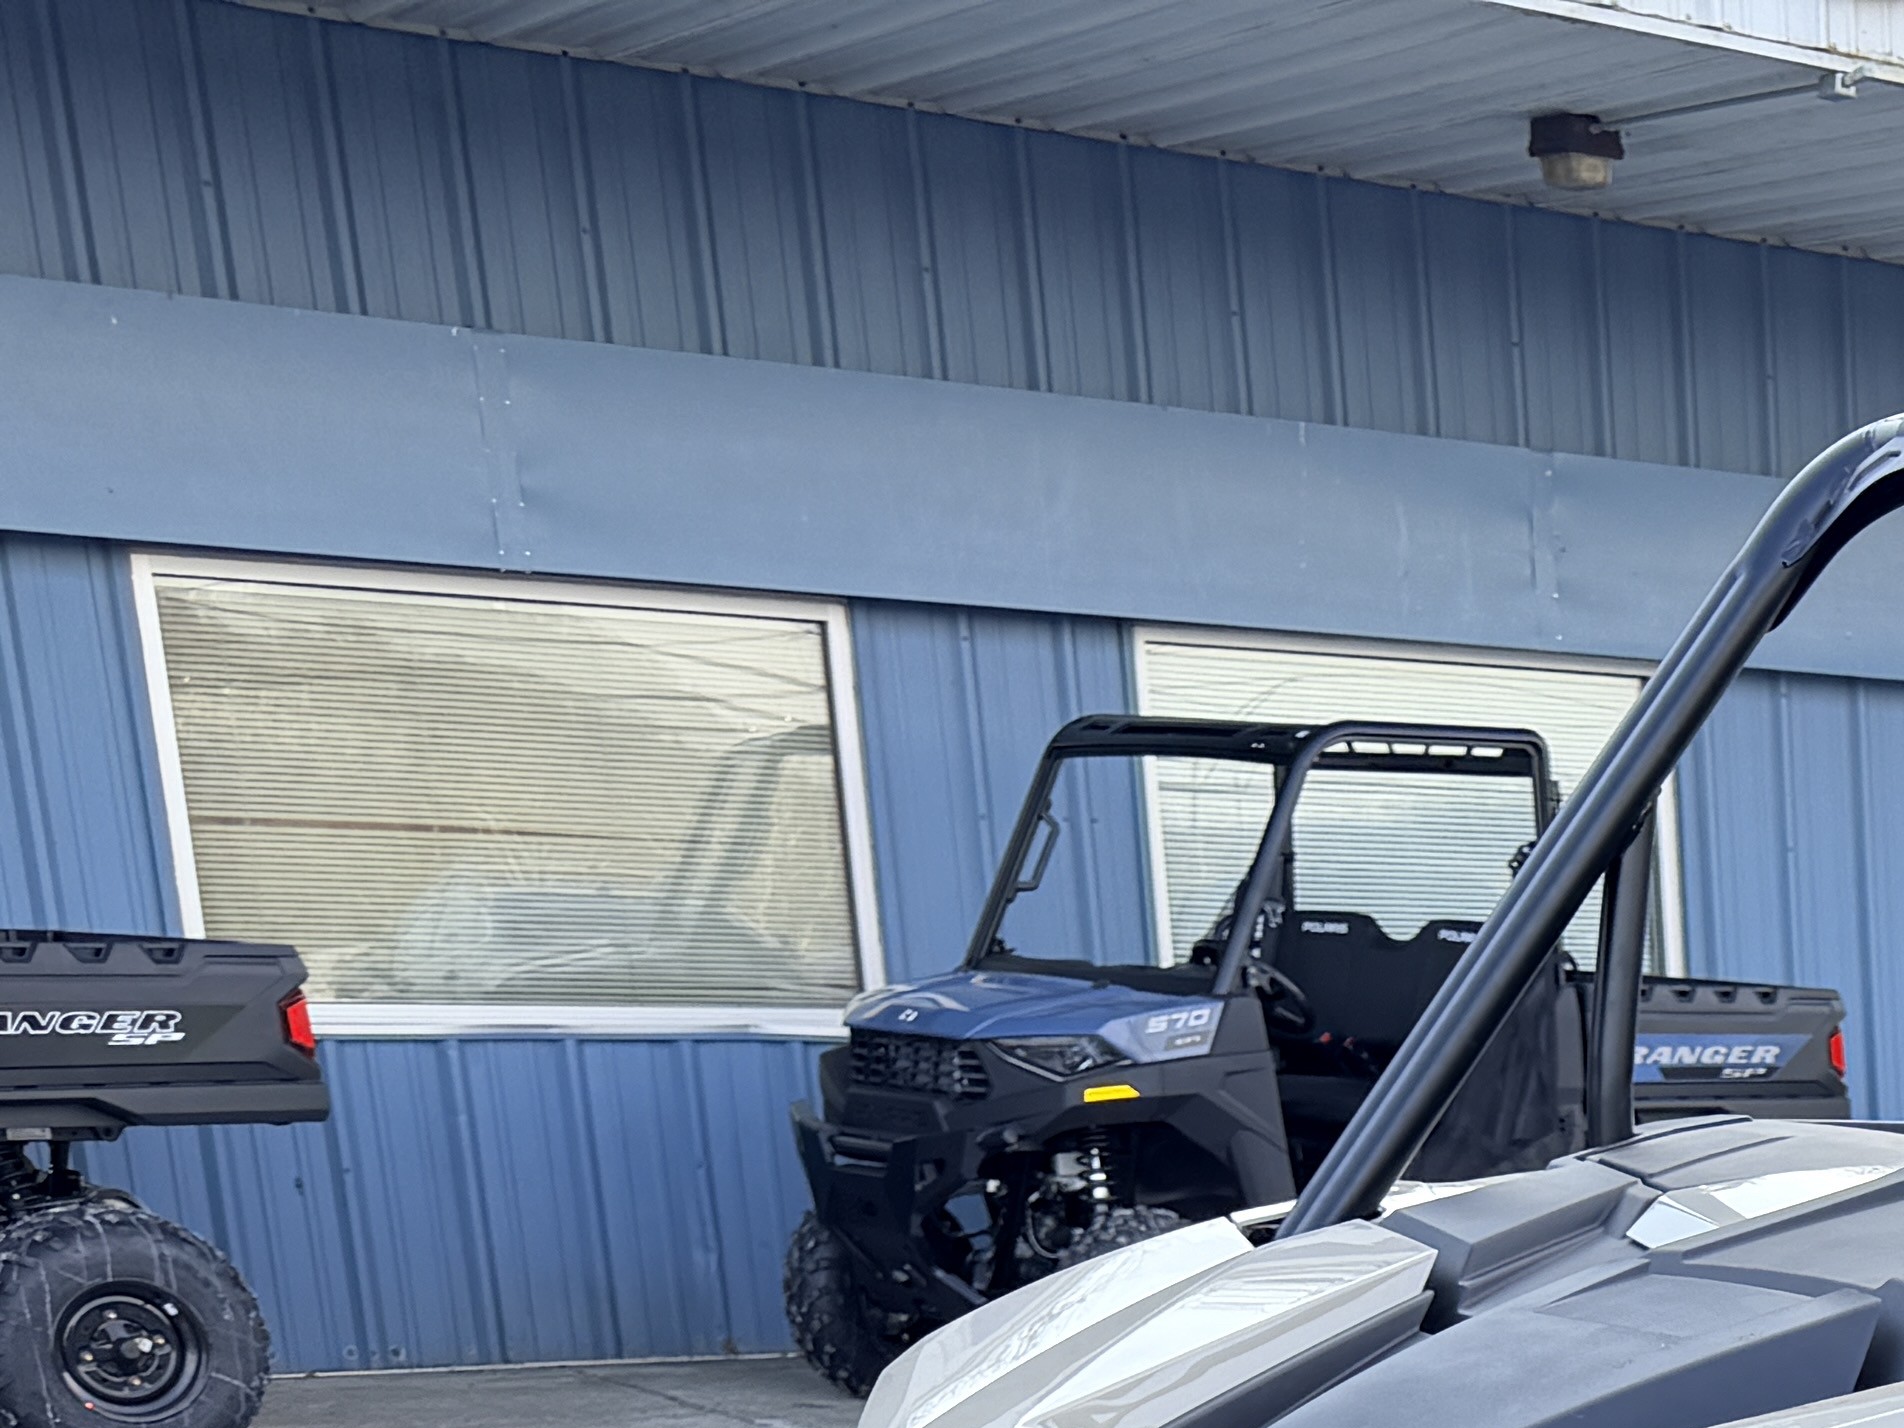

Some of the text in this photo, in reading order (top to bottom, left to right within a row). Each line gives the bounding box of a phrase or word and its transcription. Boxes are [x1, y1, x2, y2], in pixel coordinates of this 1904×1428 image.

[0, 1010, 182, 1034] NGER
[1145, 1008, 1211, 1034] 570
[107, 1033, 186, 1046] SP
